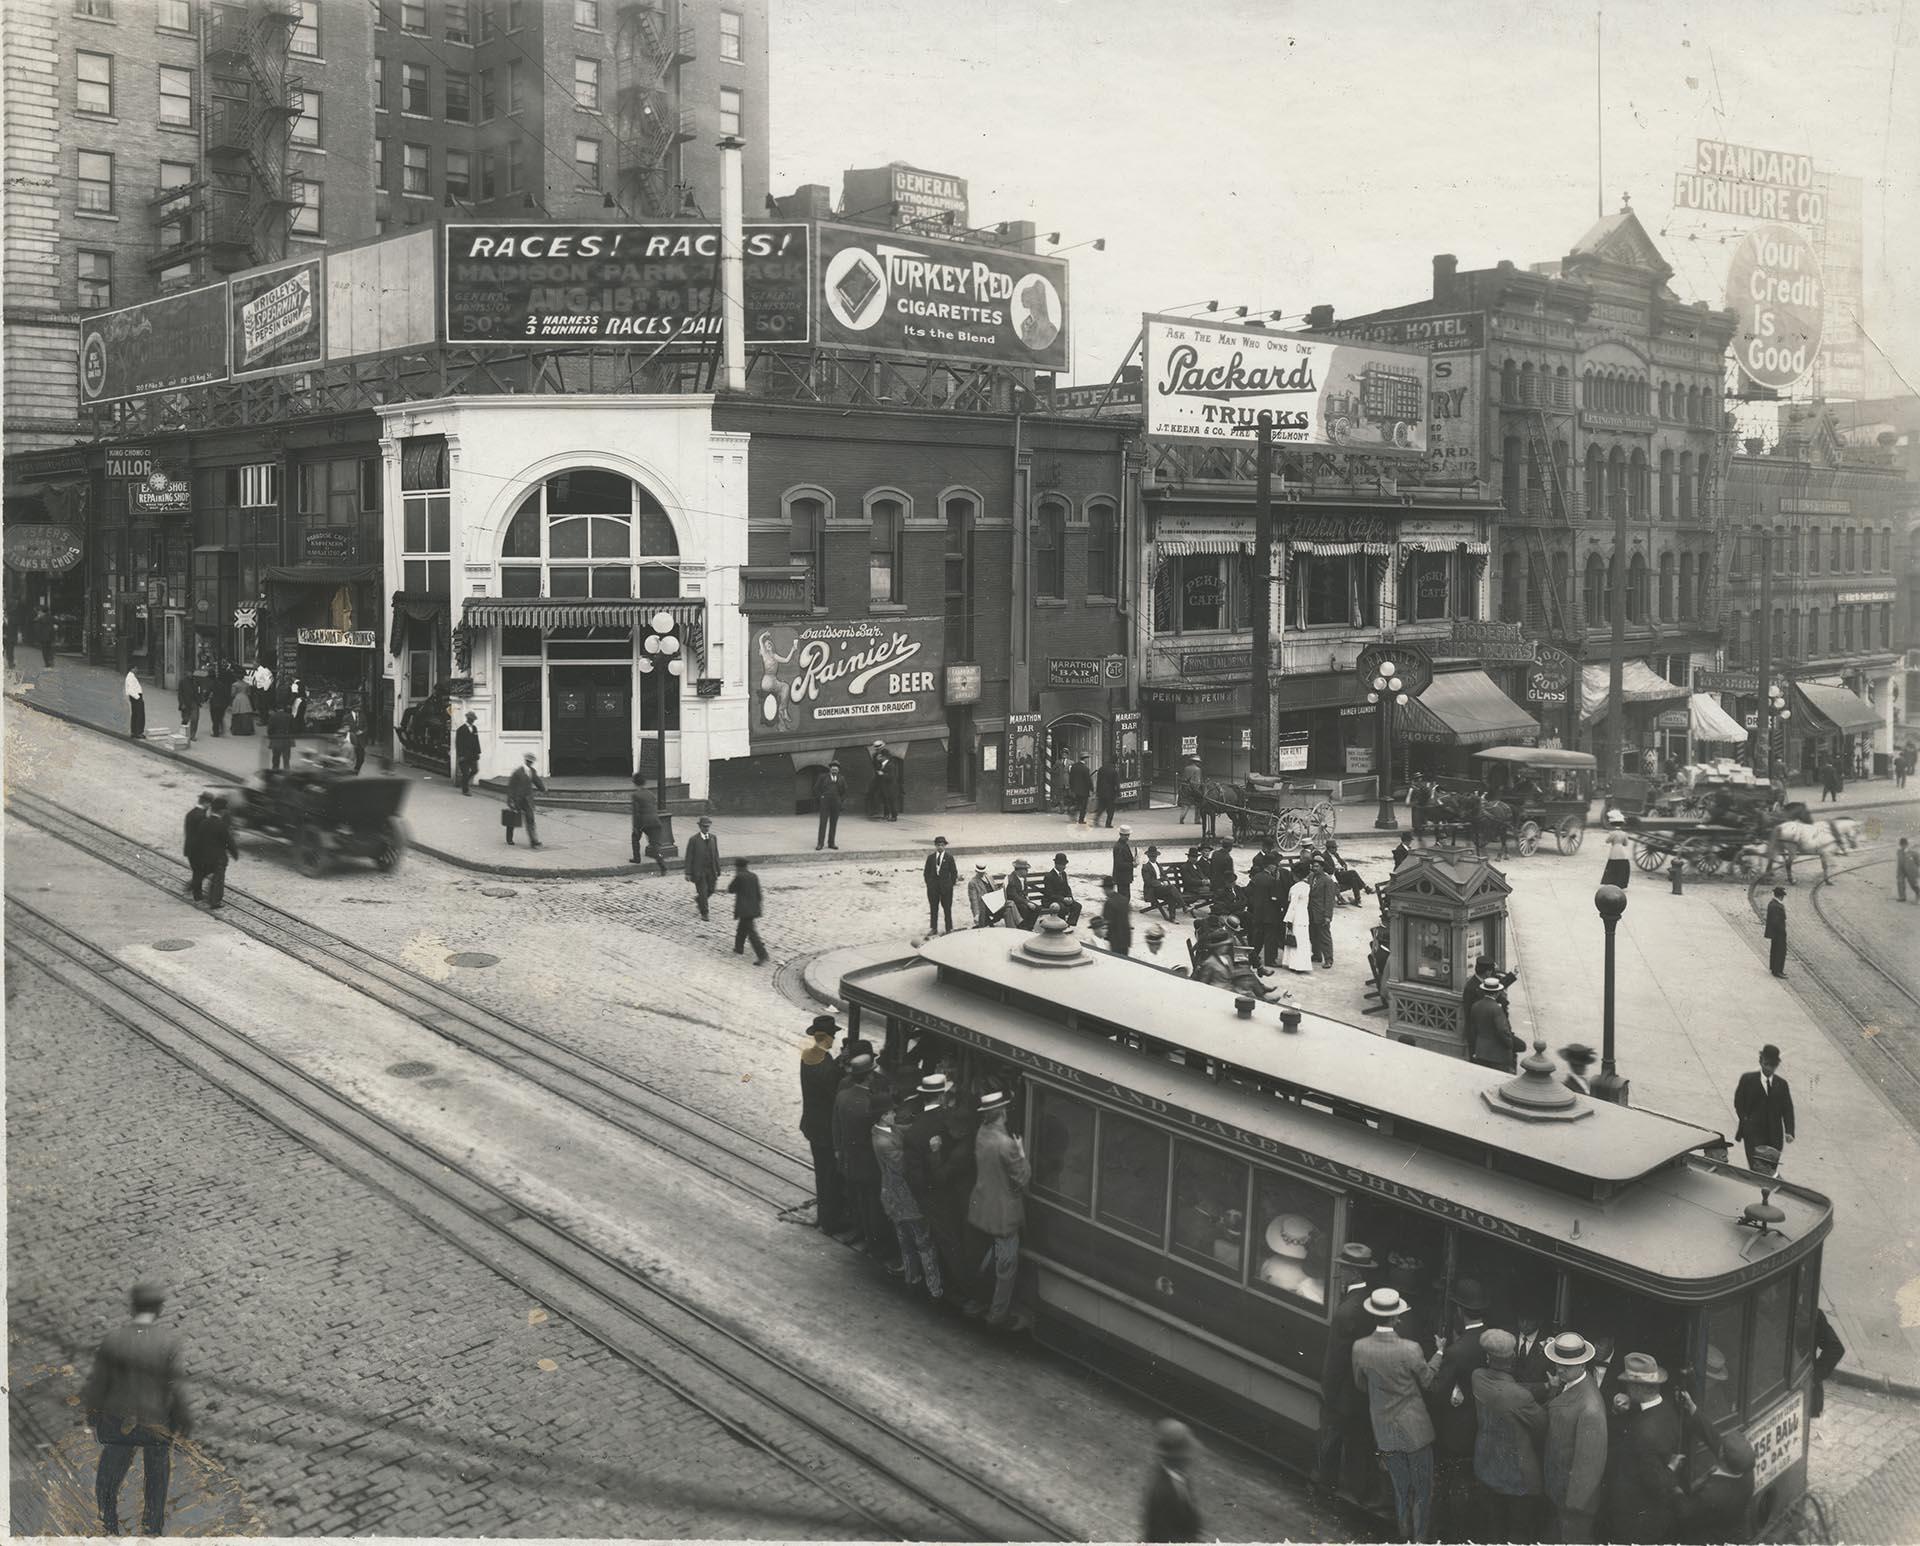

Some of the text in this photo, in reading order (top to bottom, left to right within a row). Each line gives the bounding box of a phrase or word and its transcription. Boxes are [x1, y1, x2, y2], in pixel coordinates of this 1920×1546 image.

[1698, 140, 1813, 188] STANDARD
[896, 172, 962, 199] GENERAL
[1675, 174, 1825, 224] FURNITURE CO.
[469, 232, 793, 258] RACES! RACS!
[1753, 231, 1806, 272] Your
[456, 263, 803, 281] MADISON PARK TACK
[876, 243, 1014, 304] TURKEY RED
[455, 291, 511, 302] GENERAL
[1750, 269, 1819, 309] Credit
[255, 289, 303, 330] SPEARMINT
[455, 303, 512, 313] ADMISSION
[655, 290, 681, 310] TO
[527, 316, 600, 325] 2 HARNESS
[896, 298, 1004, 326] CIGARETTES
[1753, 303, 1776, 337] Is
[255, 320, 281, 342] PEPSIN
[282, 309, 300, 328] GUM
[525, 325, 599, 335] 3 RUNNING
[605, 316, 673, 335] RACES
[1406, 318, 1467, 341] HOTEL
[929, 328, 954, 340] the
[957, 331, 996, 345] Blend
[1194, 330, 1211, 344] THE
[1218, 333, 1237, 347] MAN
[1242, 336, 1260, 349] WHO
[1266, 339, 1288, 353] OWNS
[1748, 338, 1807, 375] Good
[1158, 343, 1318, 398] Packard
[1584, 411, 1624, 425] LEXINGTON
[1204, 426, 1211, 435] &
[1212, 426, 1226, 436] CO.
[1270, 431, 1310, 442] BELMONT
[106, 459, 152, 476] TAILOR
[168, 482, 188, 491] SHOE
[138, 492, 190, 503] REPAIRING SHOP
[51, 546, 81, 569] CHOPS
[1185, 574, 1226, 594] PEKI
[1188, 594, 1227, 607] CAFE
[1455, 624, 1517, 641] MODERN
[1437, 641, 1533, 659] SHOE WORKS
[790, 632, 922, 703] Rainier
[1050, 660, 1099, 673] MARATHON
[1535, 650, 1568, 670] POOL
[1058, 669, 1090, 677] BAR
[1533, 673, 1568, 690] ROOM
[888, 671, 935, 695] BEER
[1152, 692, 1227, 704] PEKIN PEKIN
[817, 701, 914, 717] BOHEMIAN STYLE ON DRAUGHT
[1339, 705, 1378, 717] RAINIER LAUNDRY
[1009, 714, 1042, 725] MARATHON
[1016, 724, 1035, 733] BAR
[1121, 721, 1138, 731] BAR
[1010, 796, 1035, 806] BEER
[907, 1007, 994, 1049] LESCHI
[1010, 1046, 1083, 1084] PARK
[1106, 1084, 1168, 1114] AND
[1190, 1113, 1279, 1155] LAKE
[1775, 1412, 1799, 1446] BALL
[1756, 1458, 1767, 1476] TO
[1770, 1438, 1792, 1465] DAY
